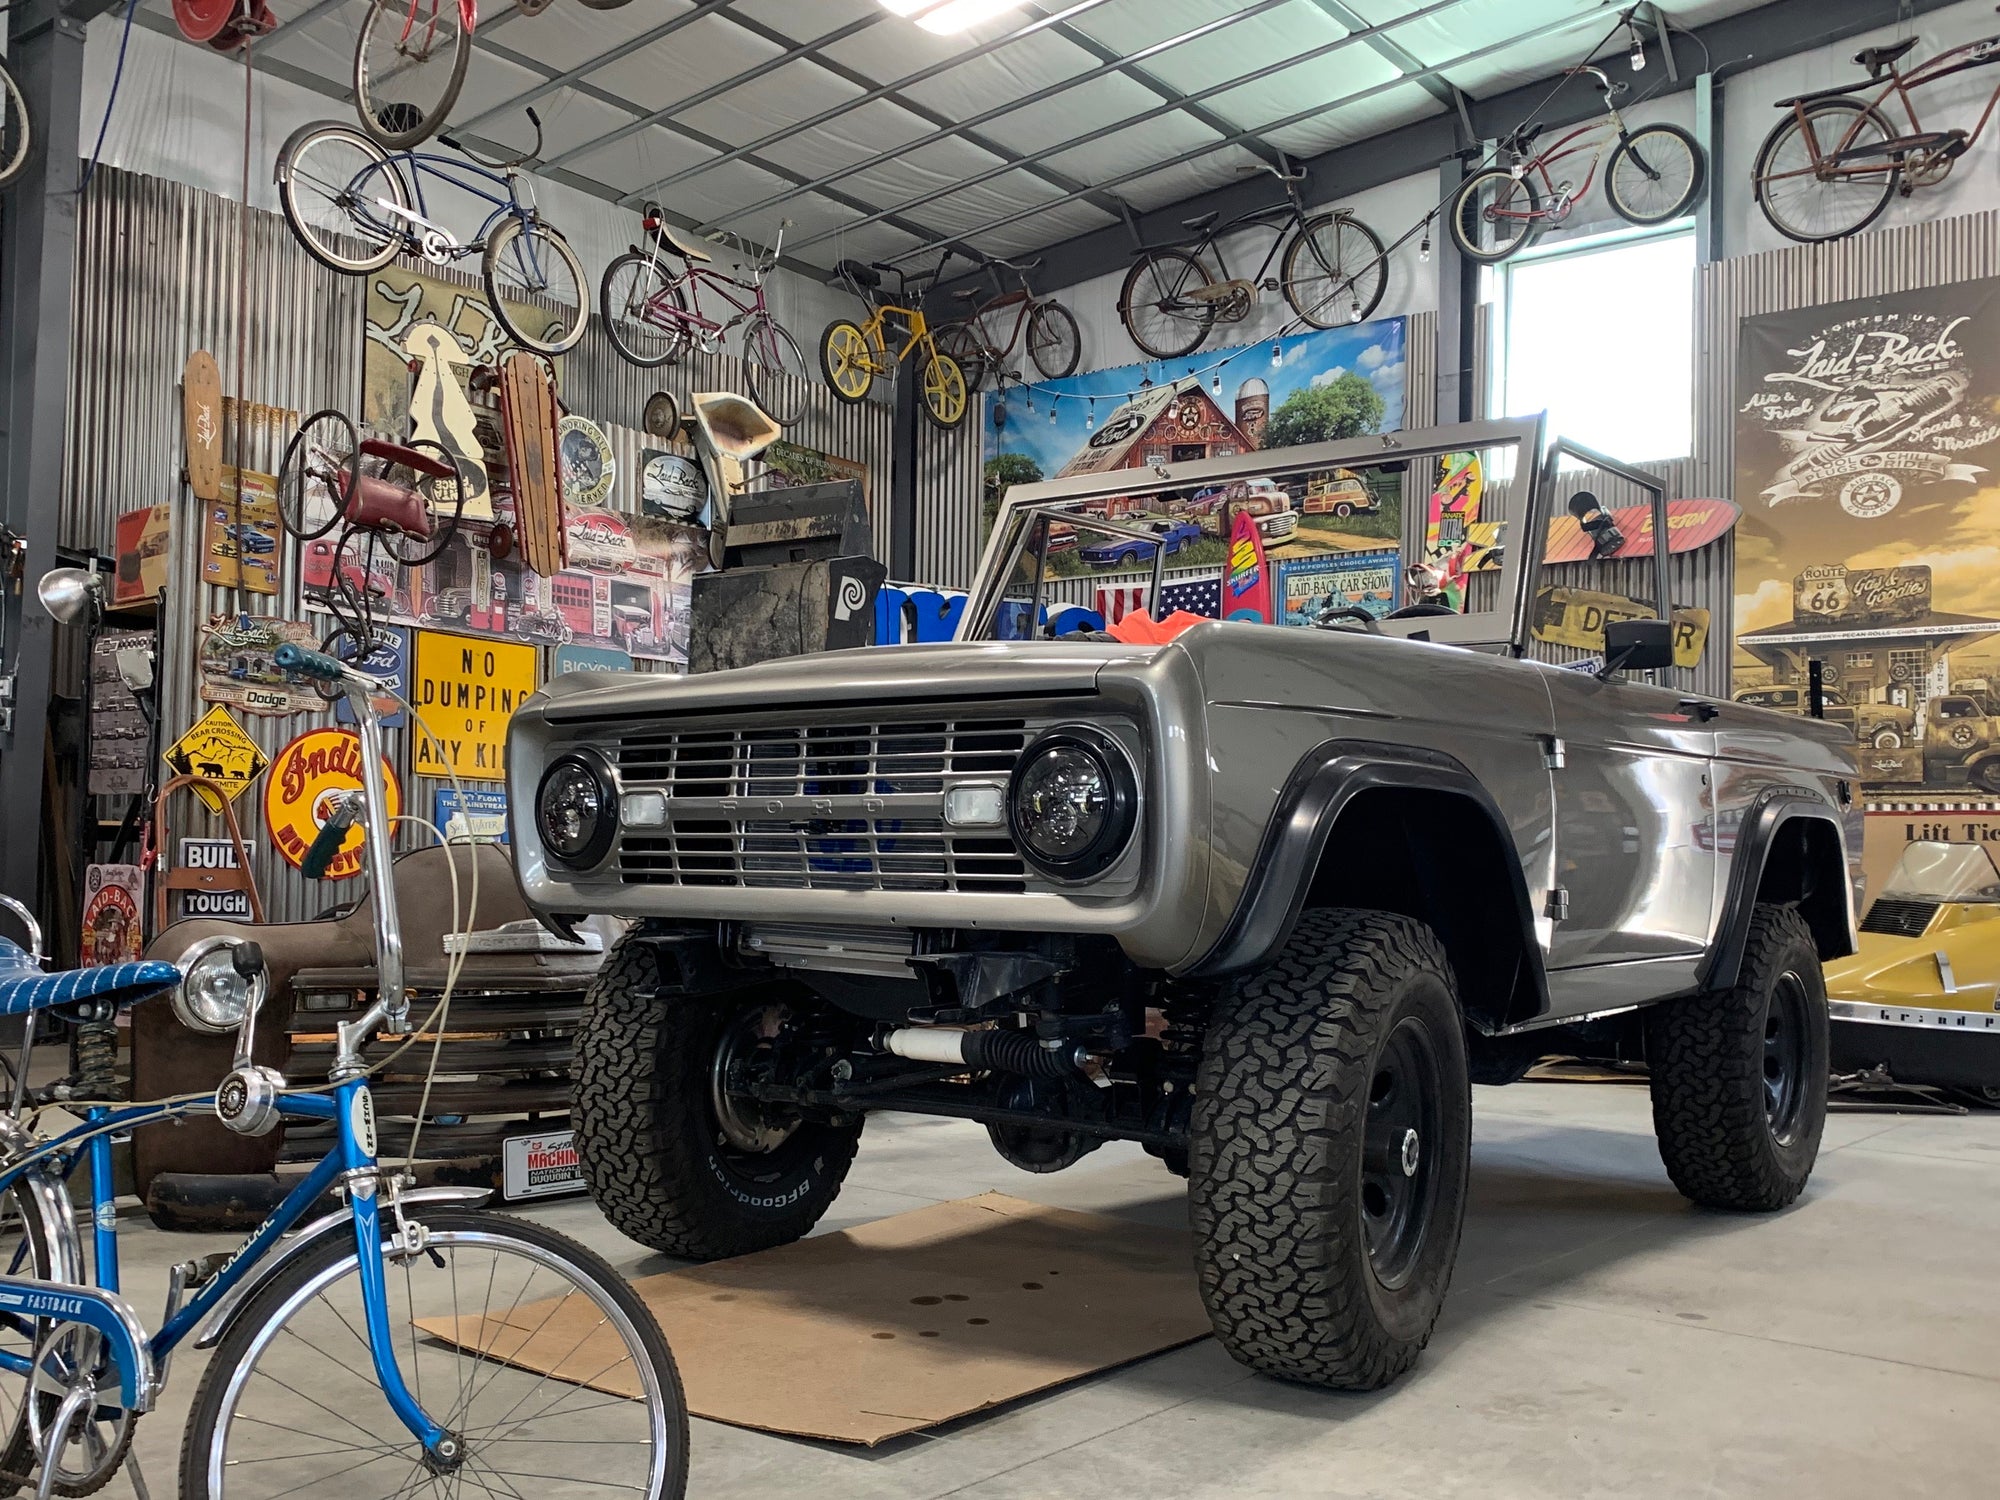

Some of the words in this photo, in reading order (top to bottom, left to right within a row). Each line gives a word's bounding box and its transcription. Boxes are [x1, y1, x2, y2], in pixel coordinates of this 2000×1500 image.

[1912, 314, 1937, 323] UP
[1764, 316, 1971, 392] Laid-Back
[1832, 362, 1950, 384] GAGE
[1783, 391, 1798, 402] &
[1763, 397, 1814, 421] Fuel
[1092, 420, 1131, 447] Ford
[1908, 413, 1963, 442] Spark
[776, 446, 805, 462] DECADES
[1811, 457, 1856, 473] COOL
[1886, 452, 1933, 462] CHILL
[1805, 464, 1858, 483] PLUGS
[1884, 460, 1942, 471] RIDES
[1847, 502, 1894, 516] GARAGE
[1641, 507, 1716, 534] BRTON
[569, 519, 628, 548] Laid-Back
[1307, 562, 1338, 570] PEOPLES
[1340, 559, 1366, 567] CHOICE
[1367, 556, 1394, 565] AWARD
[1805, 568, 1845, 579] ROUTE
[1226, 564, 1260, 587] SKURFER
[1288, 579, 1338, 597] LAID-BACK
[1340, 578, 1360, 593] CAR
[1361, 574, 1392, 591] SHOW
[1853, 570, 1883, 597] Gas
[1811, 591, 1840, 611] 66
[1865, 578, 1928, 607] Goodies
[1842, 631, 1866, 639] PECAN
[1869, 629, 1891, 637] ROLLS
[461, 648, 495, 677] NO
[246, 691, 287, 707] Dodge
[190, 728, 211, 741] BEAR
[211, 727, 248, 744] CROSSING
[465, 718, 486, 733] OF
[418, 737, 462, 766] ANY
[475, 742, 507, 770] KI
[718, 798, 885, 815] FORD
[1904, 823, 1951, 842] Lift
[188, 846, 248, 869] BUIL
[186, 895, 247, 912] TOUGH
[362, 1095, 374, 1149] SCHWINN
[528, 1149, 579, 1169] MACHIN
[197, 1218, 276, 1301] Schwinn
[27, 1294, 84, 1315] FASTBACK
